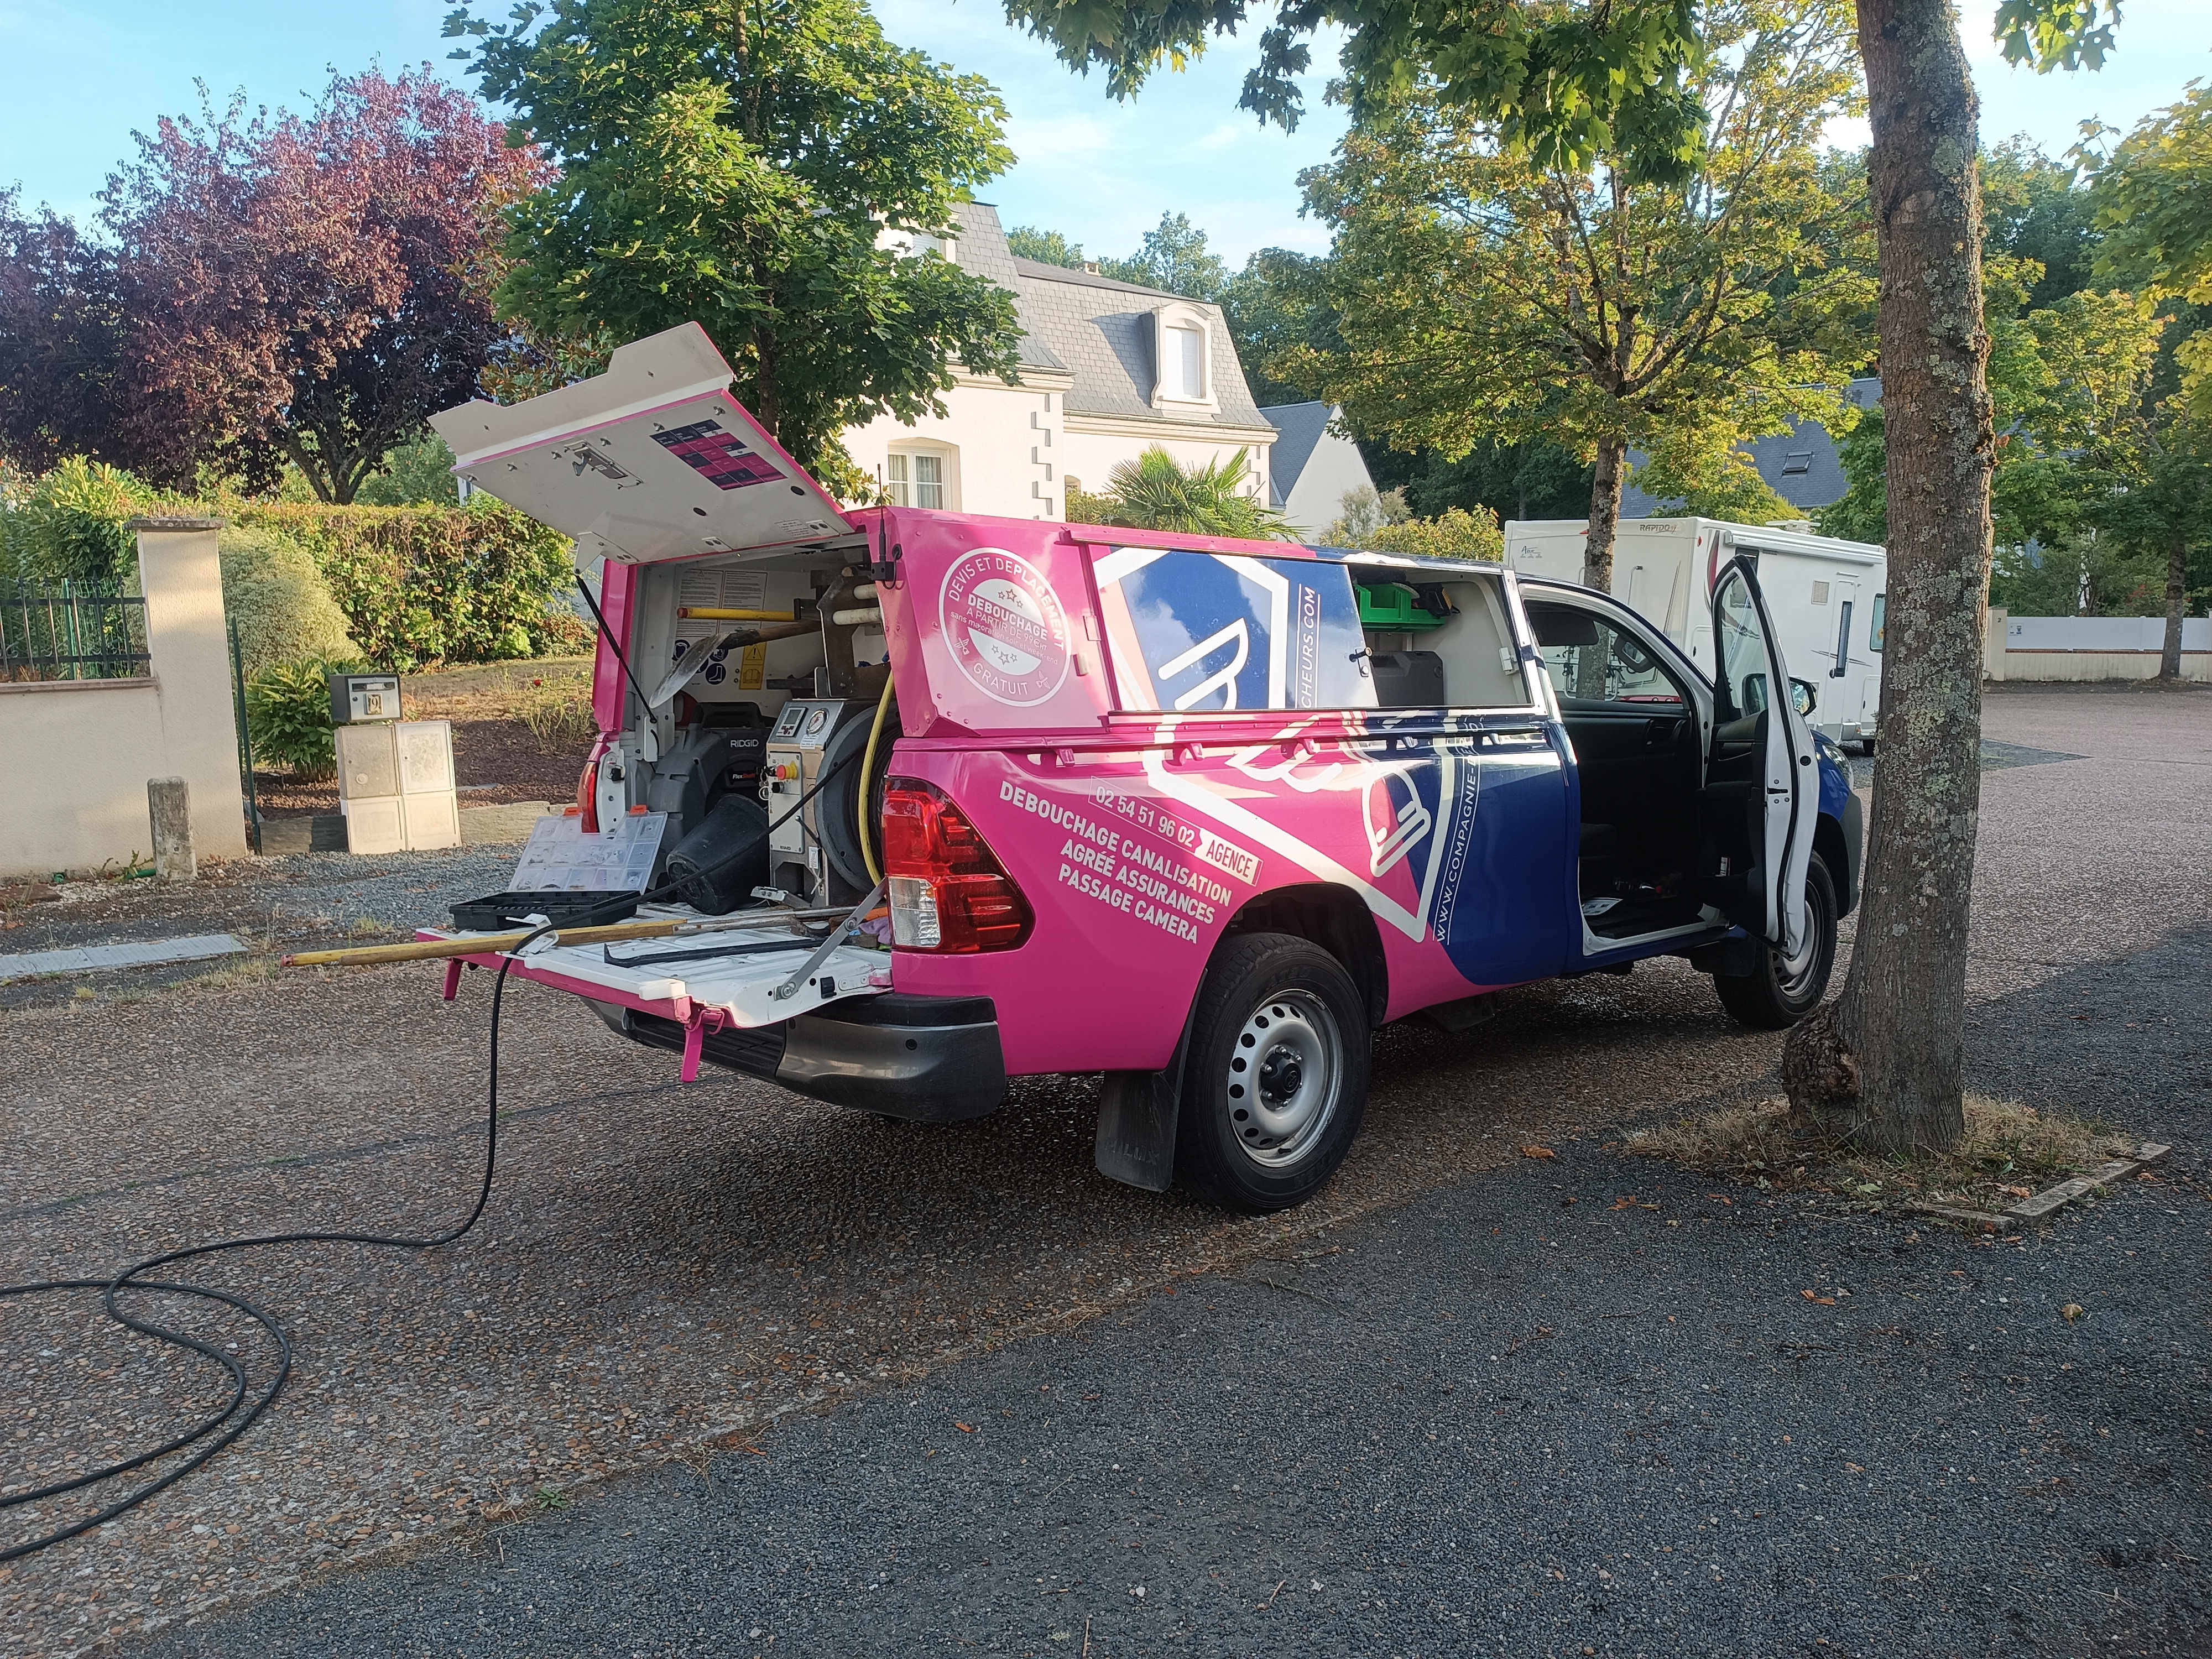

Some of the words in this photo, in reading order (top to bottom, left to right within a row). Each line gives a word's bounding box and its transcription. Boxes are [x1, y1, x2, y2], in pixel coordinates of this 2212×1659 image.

[948, 564, 975, 602] DEVIS
[975, 557, 991, 572] ET
[995, 557, 1064, 651] DEPLACEMENT
[966, 607, 973, 617] A
[975, 609, 1008, 633] PARTIR
[1010, 627, 1022, 640] DE
[968, 593, 1048, 641] DEBOUCHAGE
[951, 611, 967, 623] sans
[968, 619, 1004, 640] majoration
[1005, 635, 1018, 646] soir
[1027, 644, 1058, 665] week-end
[372, 696, 378, 710] 9
[973, 662, 1028, 696] GRATUIT
[730, 739, 759, 748] RIDGID
[999, 780, 1119, 852] DEBOUCHAGE
[1121, 839, 1233, 907] CANALISATION
[1095, 786, 1114, 808] 02
[1117, 795, 1135, 818] 54
[1138, 806, 1154, 827] 51
[1158, 815, 1176, 838] 96
[1177, 825, 1196, 848] 02
[1206, 839, 1253, 879] AGENCE
[1058, 863, 1134, 913] PASSAGE
[1134, 900, 1198, 945] CAMERA
[1060, 838, 1116, 878] AGRÉÉ
[1115, 865, 1216, 925] ASSURANCES
